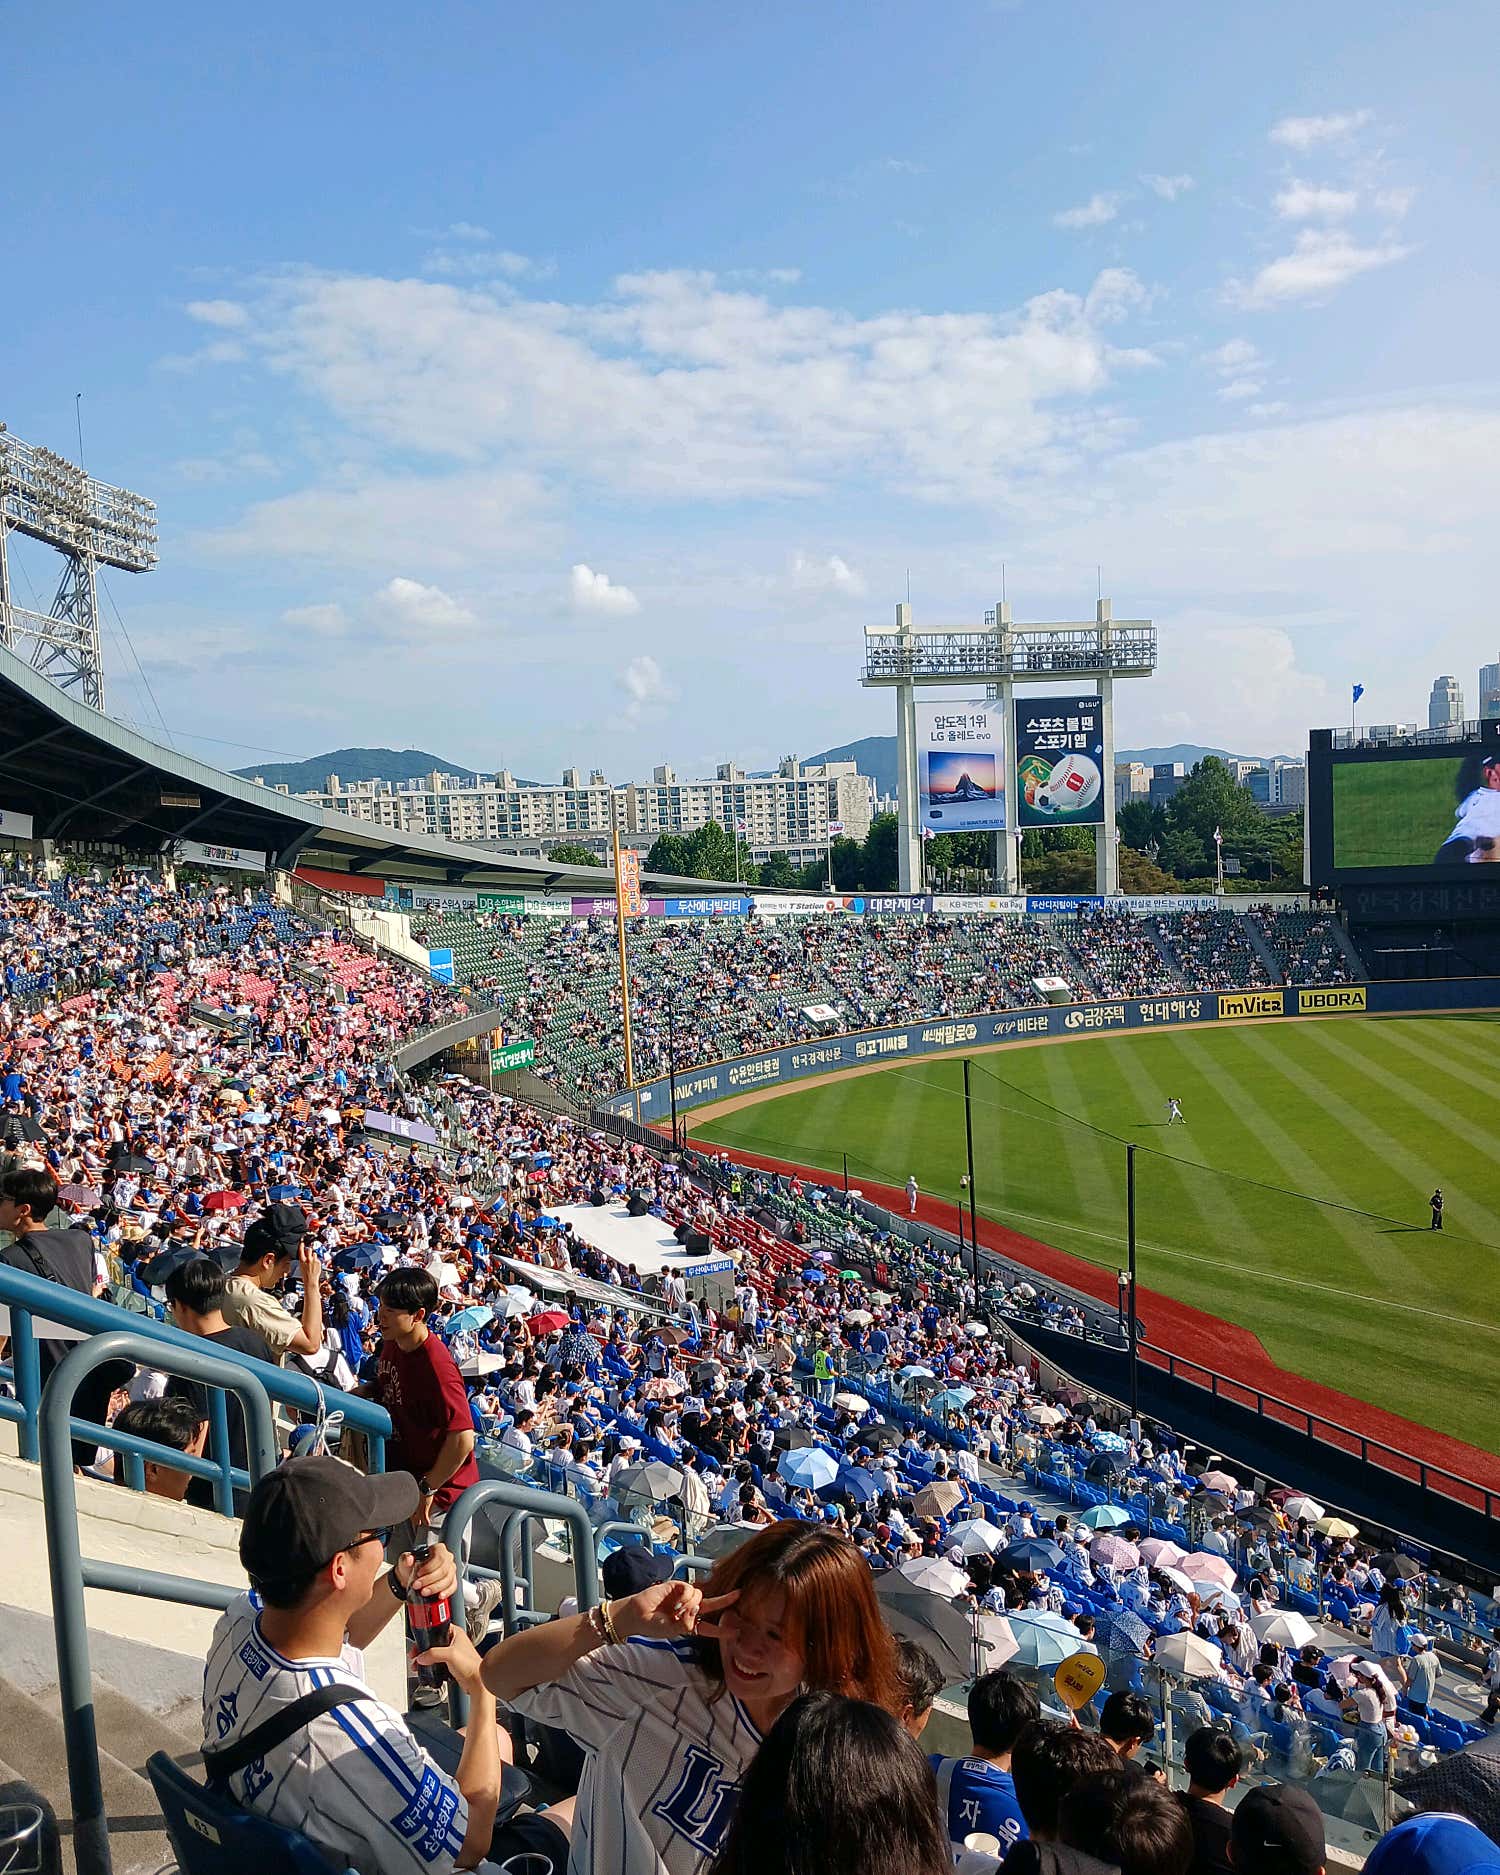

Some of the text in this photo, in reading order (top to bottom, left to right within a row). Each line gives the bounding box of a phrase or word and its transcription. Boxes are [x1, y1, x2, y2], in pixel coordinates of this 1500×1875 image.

[934, 714, 988, 729] 압도적 1위
[1026, 718, 1064, 733] 스포츠
[1066, 717, 1078, 732] 볼
[931, 733, 944, 742] LG
[948, 731, 975, 742] 올레드
[1034, 733, 1088, 750] 스포키 앱
[480, 898, 493, 909] DB
[678, 900, 740, 913] 두산에너빌리티
[870, 898, 926, 912] 대화제약
[1301, 992, 1364, 1008] UBORA
[1084, 1006, 1124, 1027] 금강주택
[1139, 1000, 1202, 1022] 현대해상
[1017, 1016, 1048, 1032] 비타란
[792, 1047, 842, 1068] 한국경제신문
[738, 1058, 780, 1077] 유안타증권
[400, 1774, 436, 1830] 대구대학교
[424, 1794, 456, 1854] 삼성화재
